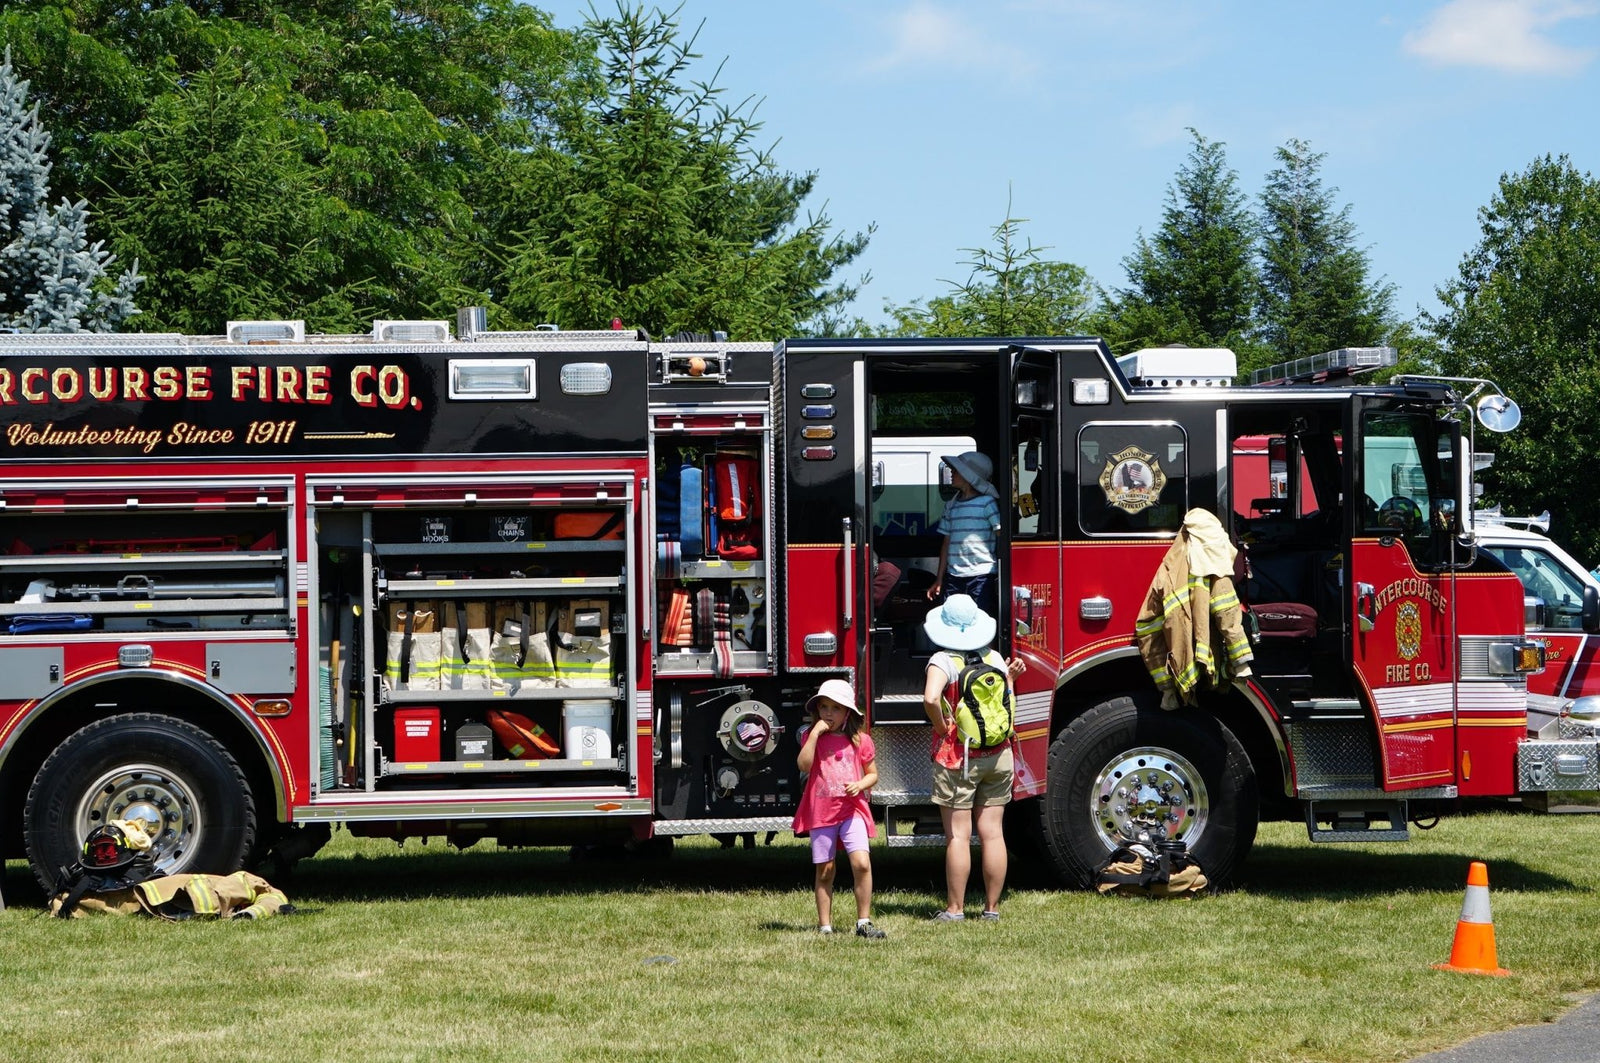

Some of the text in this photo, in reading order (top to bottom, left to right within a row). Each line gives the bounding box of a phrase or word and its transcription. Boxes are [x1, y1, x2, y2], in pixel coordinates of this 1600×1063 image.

[231, 366, 332, 403] FIRE
[350, 365, 421, 410] CO.
[7, 421, 297, 454] Volunteering Since 1911
[1118, 451, 1147, 460] HONOR
[497, 529, 525, 537] CHAINS
[1374, 578, 1448, 616] NTERCOURSE
[1386, 662, 1432, 682] FIRE CO.
[1070, 728, 1131, 813] MICHELIN
